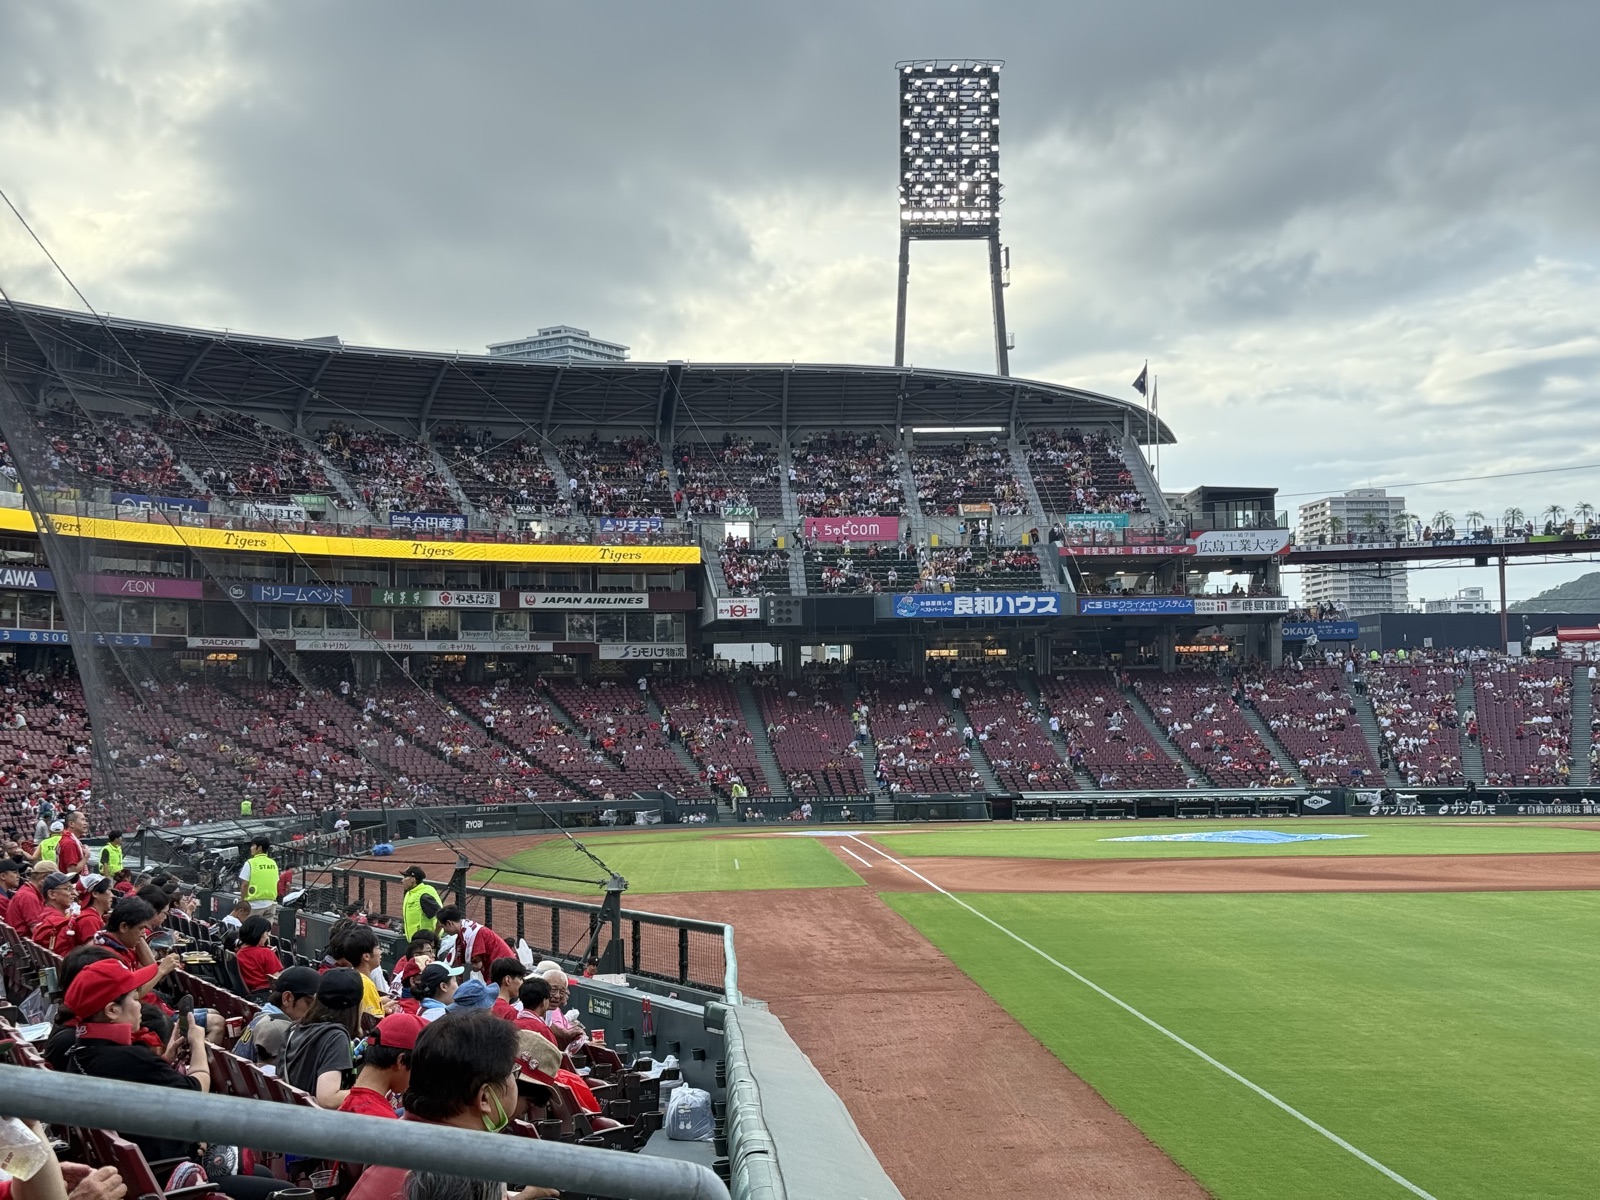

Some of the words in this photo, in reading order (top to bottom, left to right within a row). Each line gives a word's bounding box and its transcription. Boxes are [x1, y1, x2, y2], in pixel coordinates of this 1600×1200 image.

[224, 532, 267, 548] Tigers
[411, 543, 454, 558] Tigers
[1200, 539, 1280, 553] 広島工業大学
[599, 548, 642, 562] Tigers
[261, 586, 344, 603] ドリームベッド
[954, 596, 1058, 615] 良和ハウス
[1104, 600, 1192, 608] 日本クライメイトシステムズ
[1282, 627, 1315, 635] OKATA
[43, 633, 69, 642] SOG
[632, 646, 685, 657] シモハナ物流
[1381, 805, 1425, 815] サンセルモ
[1450, 805, 1496, 815] サンセルモ
[1527, 805, 1580, 814] 自動車保険は
[465, 820, 483, 829] RYOBI
